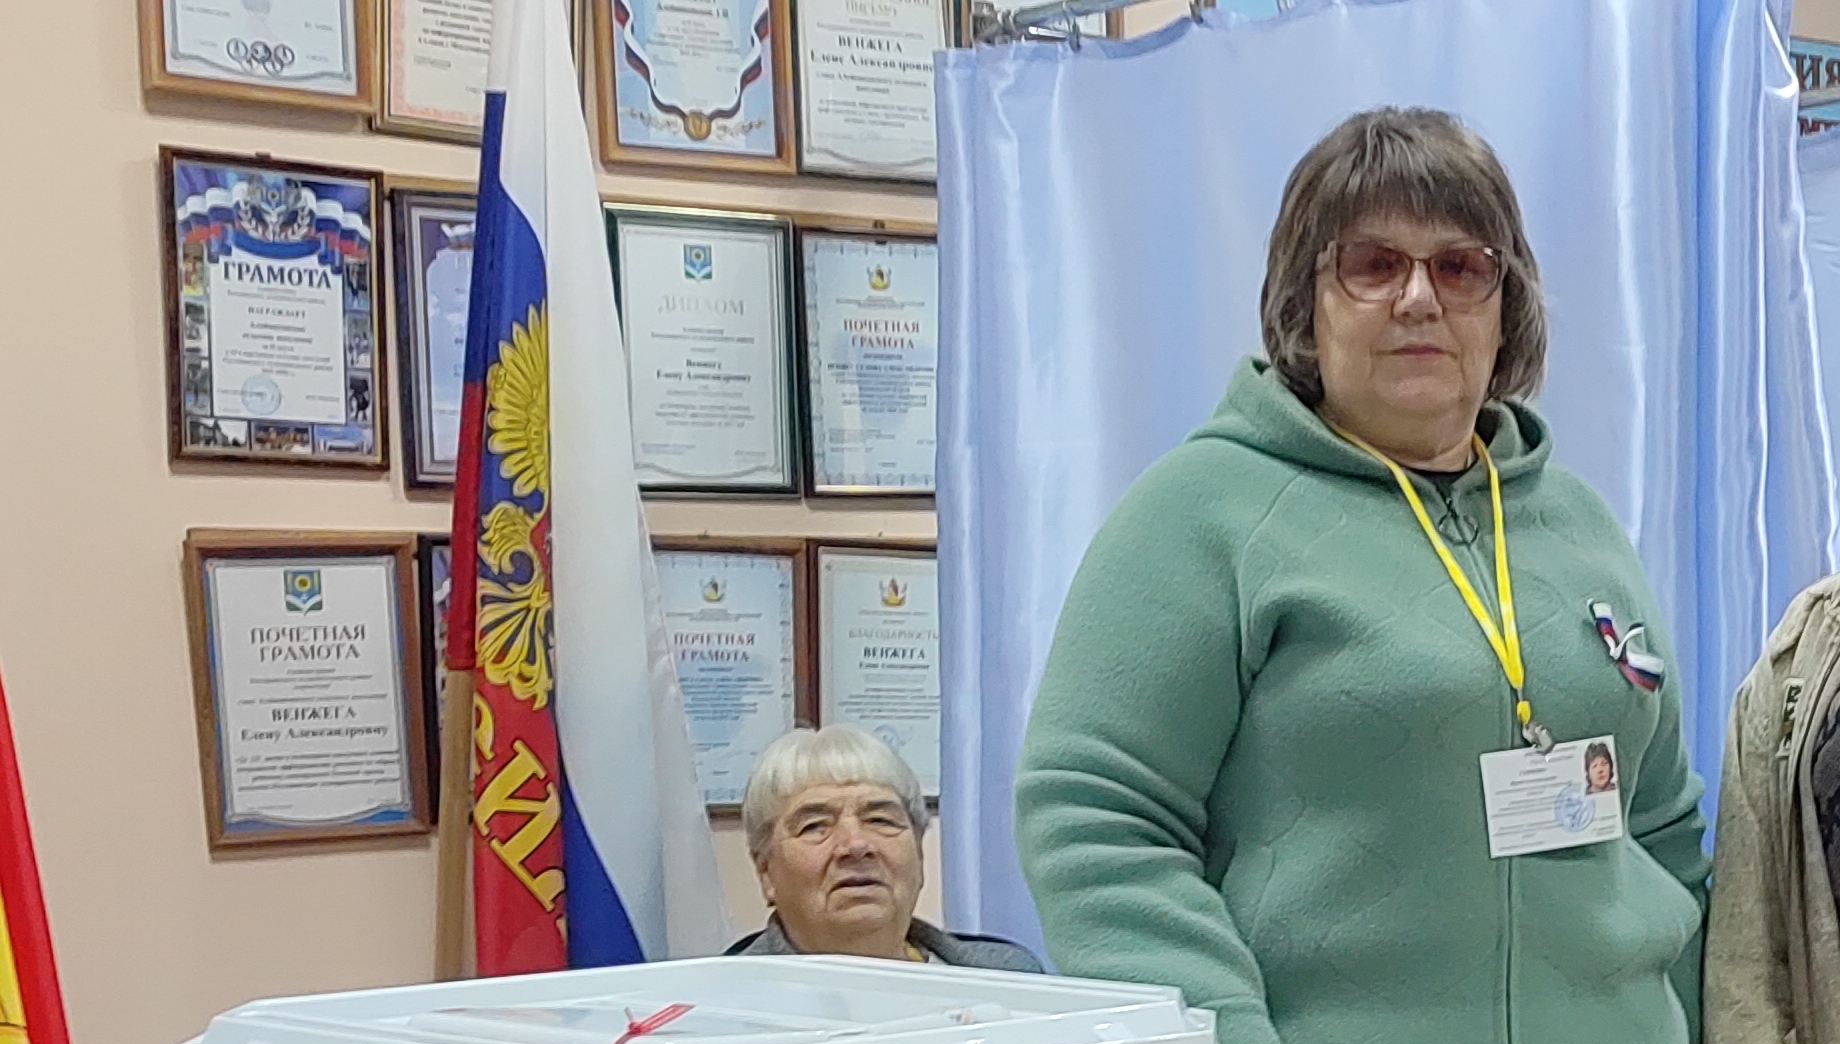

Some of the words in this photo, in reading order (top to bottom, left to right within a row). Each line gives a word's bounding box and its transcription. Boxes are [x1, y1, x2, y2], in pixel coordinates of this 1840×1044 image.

[223, 261, 332, 290] ГРАМОТА
[843, 319, 920, 334] ПОЧЕТНАЯ
[851, 335, 915, 350] ГРАМОТА
[250, 624, 366, 644] ПОЧЕТНАЯ
[674, 632, 755, 646] ПОЧЕТНАЯ
[259, 643, 361, 662] ГРАМОТА
[681, 649, 750, 662] ГРАМОТА
